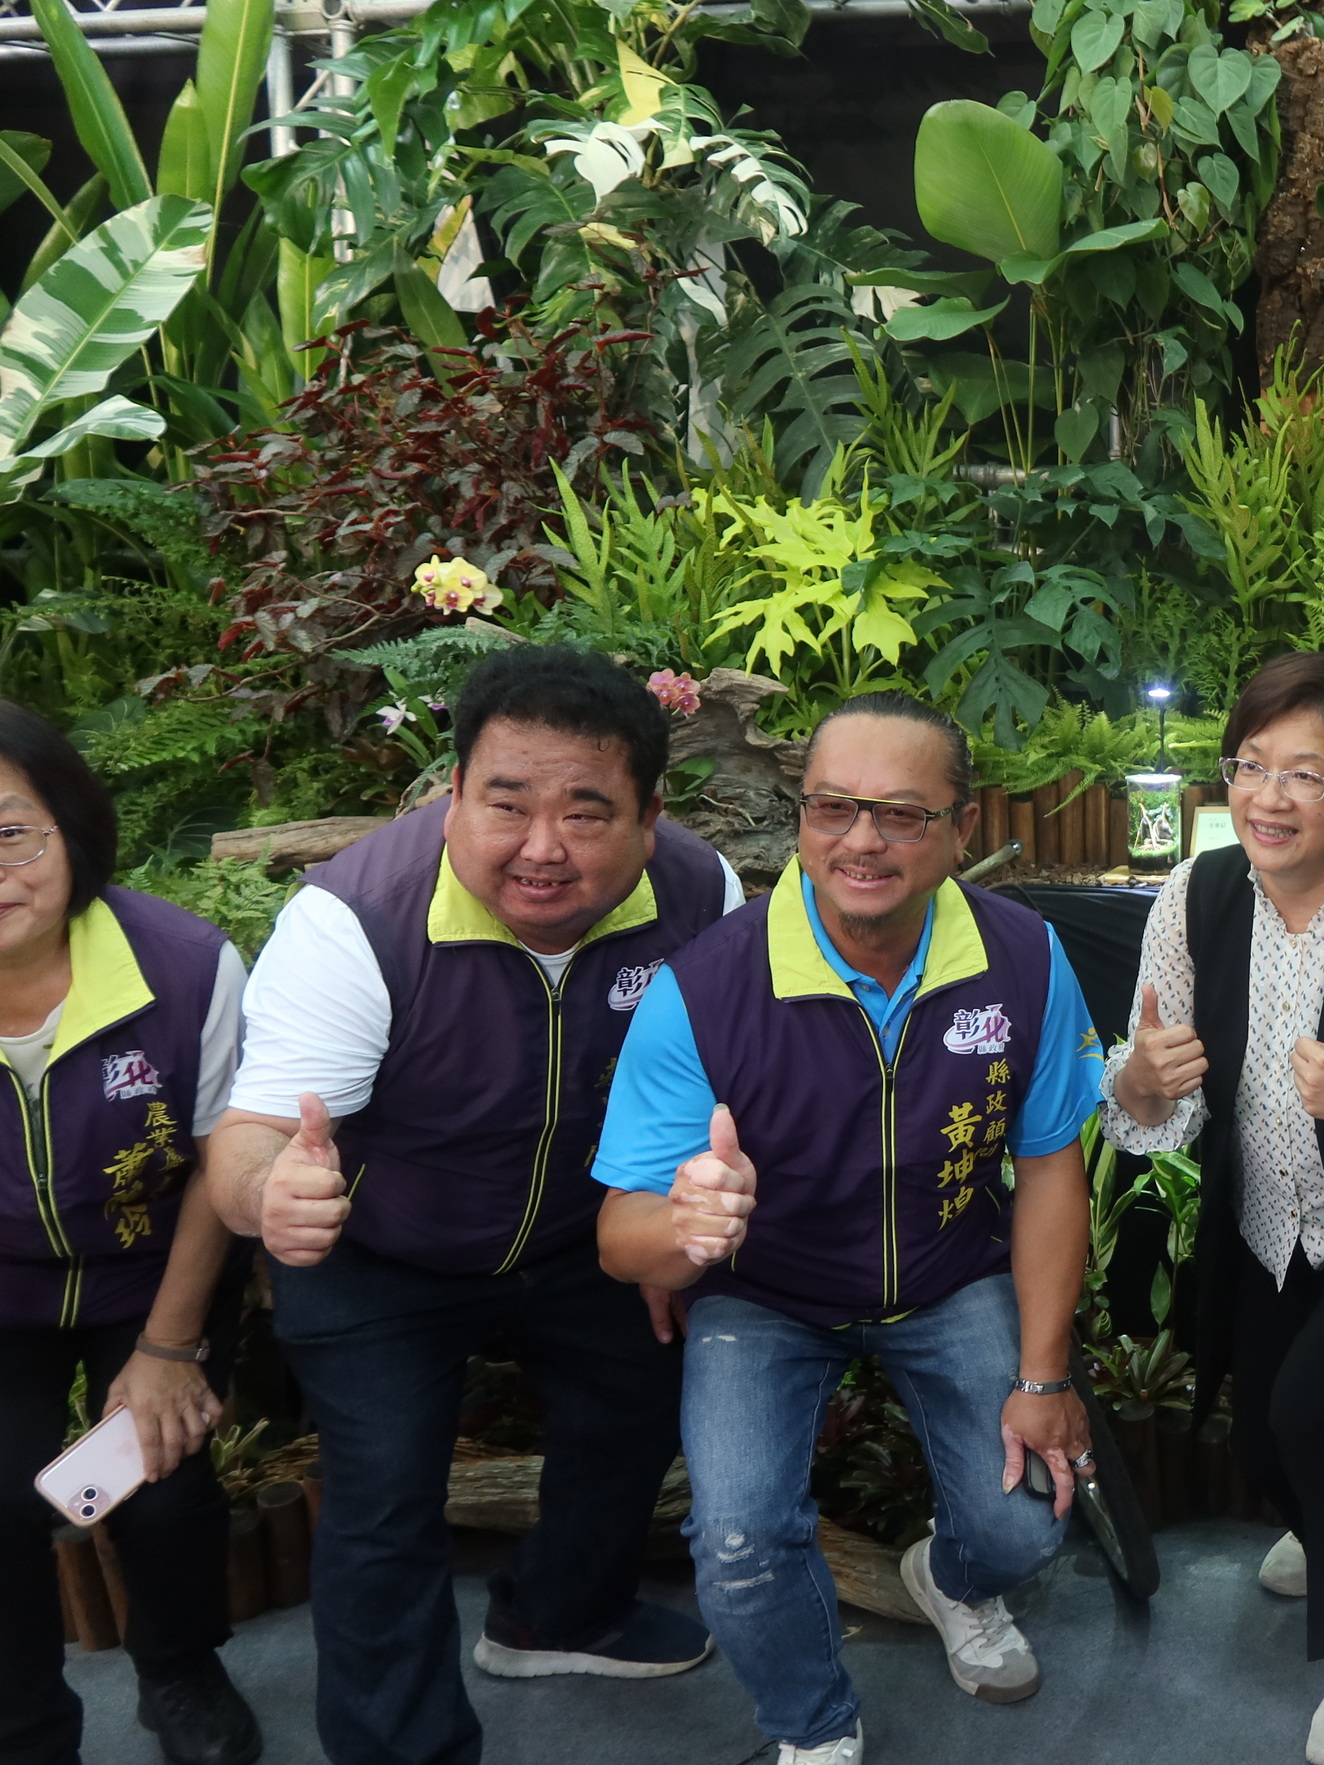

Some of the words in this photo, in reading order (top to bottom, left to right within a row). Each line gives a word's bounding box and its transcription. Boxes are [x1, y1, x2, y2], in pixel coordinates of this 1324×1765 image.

[951, 1004, 1011, 1046] 彰化
[937, 1102, 982, 1232] 黃坤煌
